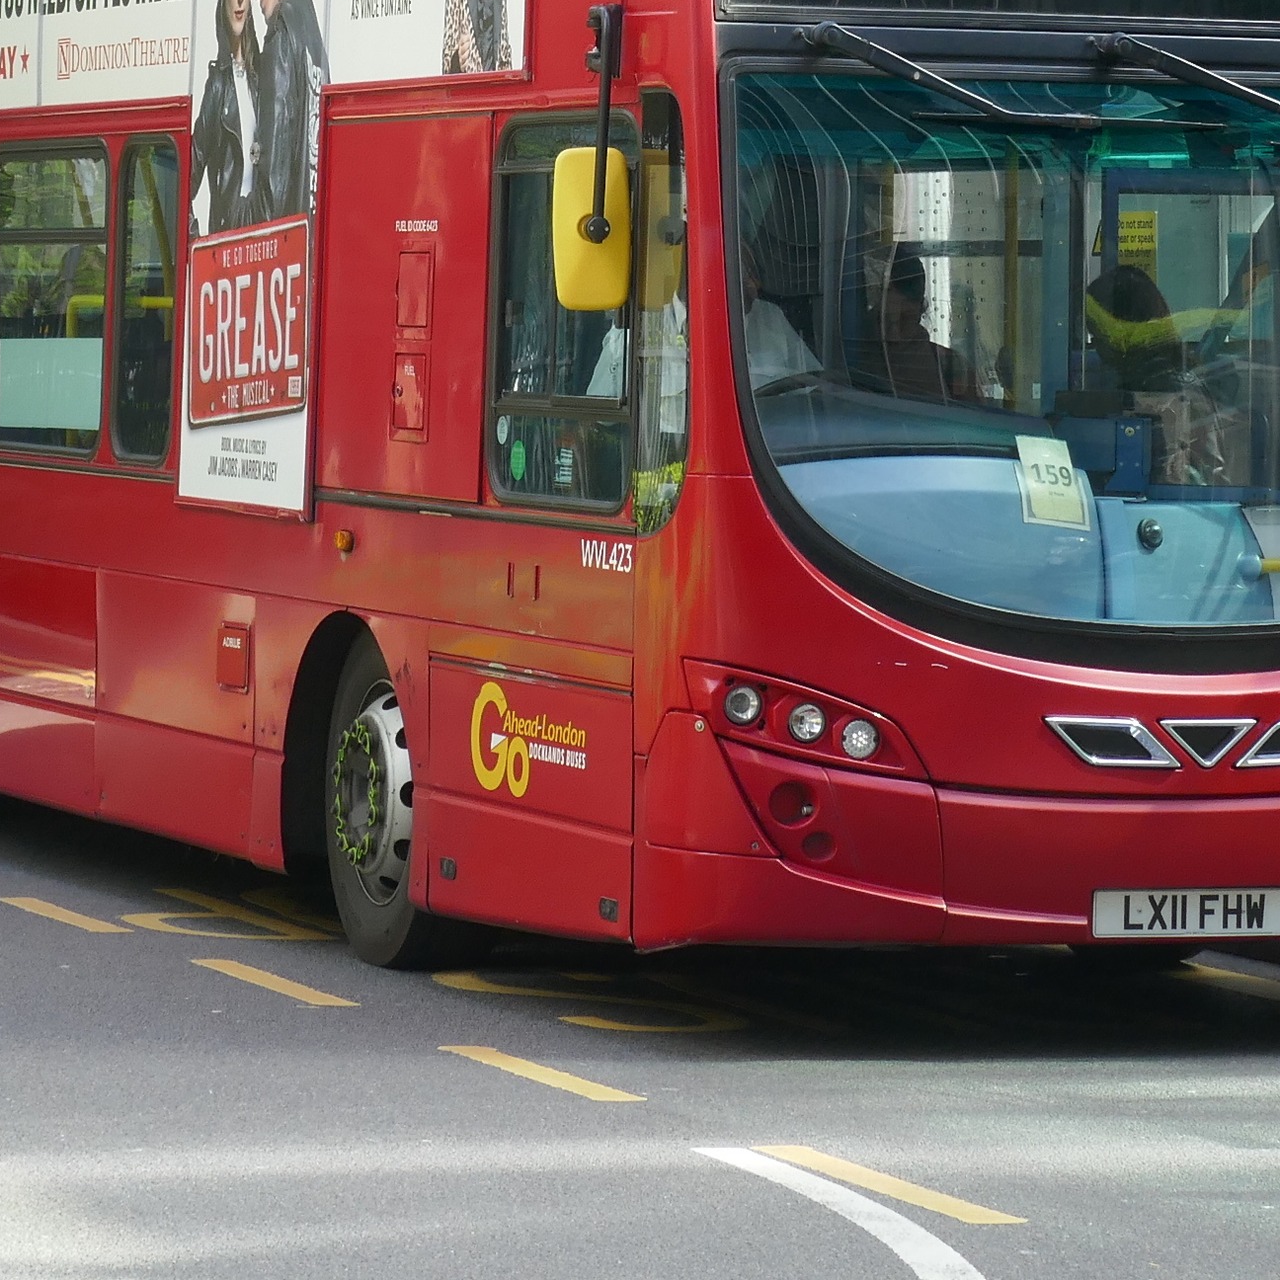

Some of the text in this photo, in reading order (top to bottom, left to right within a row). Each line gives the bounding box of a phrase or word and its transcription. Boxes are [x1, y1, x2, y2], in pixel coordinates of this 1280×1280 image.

[222, 239, 278, 268] WE GO TOGETHER
[199, 263, 301, 384] GREASE
[227, 384, 239, 409] THE
[242, 379, 270, 407] MUSICAL
[1031, 463, 1072, 487] 159
[581, 538, 633, 573] WVL423
[471, 681, 530, 798] Go
[503, 709, 586, 748] Ahead-London
[529, 742, 586, 770] DOCKLANDS BUSES
[1123, 893, 1266, 930] LX11 FHW
